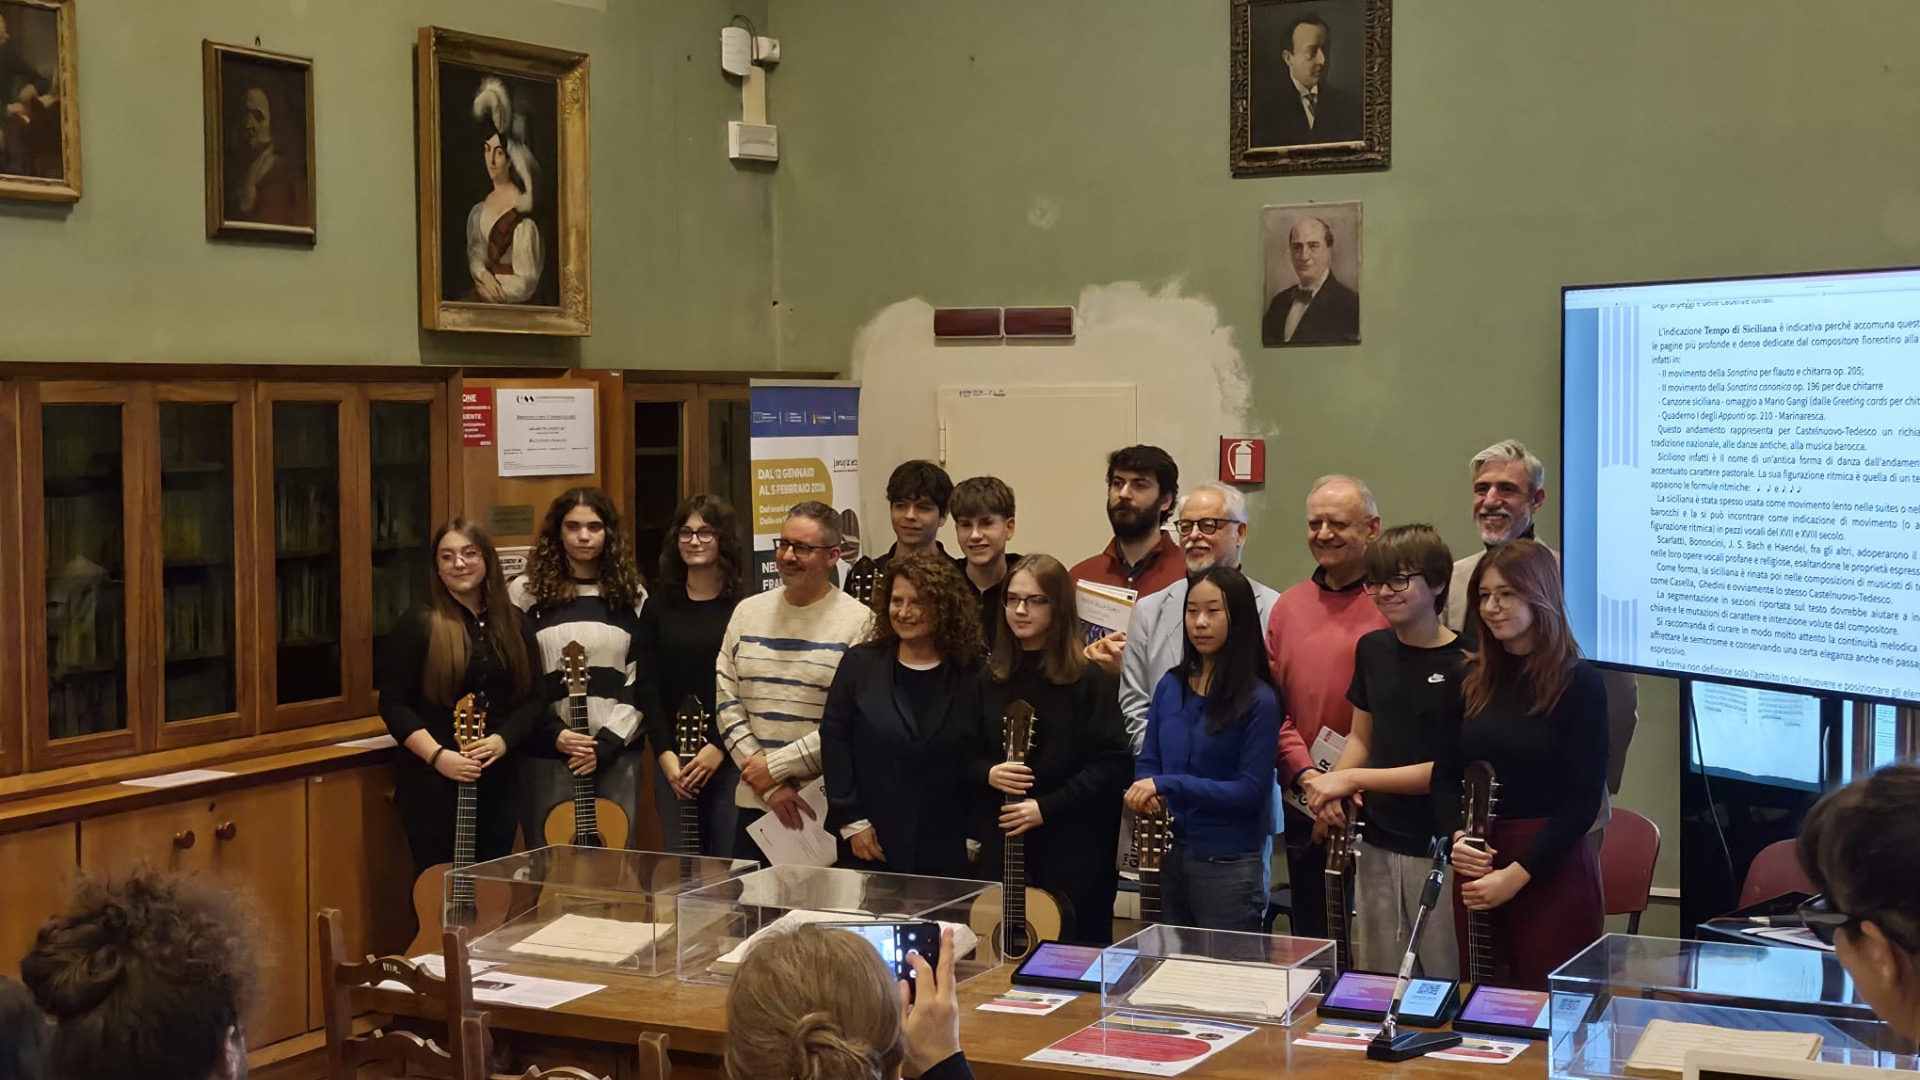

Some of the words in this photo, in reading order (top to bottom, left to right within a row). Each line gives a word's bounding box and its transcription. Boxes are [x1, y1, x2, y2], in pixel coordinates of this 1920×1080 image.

[1704, 325, 1730, 336] Tempo
[1786, 322, 1822, 332] indicativa
[1824, 320, 1851, 332] perché
[1854, 321, 1894, 329] accomuna
[1660, 341, 1682, 352] pagine
[1698, 339, 1730, 351] profonde
[1739, 338, 1760, 347] dense
[1762, 337, 1794, 347] dedicate
[1811, 336, 1859, 347] compositore
[1862, 335, 1901, 344] fiorentino
[1651, 354, 1671, 363] infatti
[1668, 368, 1706, 377] movimento
[1708, 367, 1725, 376] della
[1773, 366, 1794, 376] flauto
[1802, 366, 1832, 375] chitarra
[1668, 383, 1706, 391] movimento
[1708, 382, 1725, 391] della
[1807, 381, 1820, 390] 196
[1853, 381, 1883, 390] chitarre
[1662, 396, 1691, 405] Canzone
[1692, 396, 1720, 405] siciliana
[1726, 396, 1757, 407] omaggio
[1764, 396, 1784, 405] Mario
[1833, 396, 1864, 407] Greeting
[1662, 410, 1695, 421] Quaderno
[1700, 410, 1718, 421] degli
[1760, 410, 1773, 419] 210
[1779, 410, 1825, 420] Marinaresca.
[1658, 424, 1681, 435] Questo
[1685, 424, 1725, 434] andamento
[1796, 425, 1877, 435] Castelnuovo-Tedesco
[1651, 437, 1685, 447] tradizione
[1686, 438, 1721, 450] nazionale,
[1723, 438, 1735, 448] alle
[1736, 439, 1758, 448] danze
[1760, 440, 1788, 451] antiche,
[1790, 440, 1804, 449] alla
[1805, 441, 1832, 450] musica
[1689, 452, 1708, 461] infatti
[1762, 454, 1796, 463] un'antica
[1799, 454, 1822, 464] forma
[1837, 456, 1860, 465] danza
[758, 468, 774, 480] DAL
[782, 468, 814, 479] GENNAIO
[1651, 466, 1688, 475] accentuato
[1689, 467, 1720, 476] carattere
[1721, 468, 1756, 478] pastorale.
[1783, 469, 1824, 480] figurazione
[1826, 471, 1854, 480] ritmica
[1862, 472, 1887, 483] quella
[759, 485, 770, 496] AL
[776, 483, 810, 494] FEBBRAIO
[1651, 480, 1682, 490] appaiono
[1691, 480, 1718, 490] formule
[1666, 494, 1694, 503] siciliana
[1701, 495, 1718, 504] stata
[1719, 498, 1743, 507] spesso
[1745, 498, 1764, 506] usata
[1788, 500, 1830, 509] movimento
[1832, 500, 1852, 510] lento
[1854, 501, 1873, 511] nelle
[1875, 503, 1898, 512] suites
[1651, 506, 1679, 516] barocchi
[1728, 511, 1764, 521] incontrare
[1768, 514, 1788, 522] come
[1793, 514, 1835, 524] indicazione
[1852, 518, 1897, 527] movimento
[1651, 520, 1687, 531] figurazione
[1689, 523, 1715, 534] ritmica)
[1724, 526, 1742, 535] pezzi
[1744, 526, 1765, 535] vocali
[1780, 527, 1793, 537] XVII
[1800, 528, 1817, 538] XVIII
[1819, 530, 1846, 540] secolo.
[1747, 540, 1764, 549] Bach
[1775, 541, 1808, 554] Haendel,
[1857, 547, 1909, 559] adoperarono
[1651, 547, 1666, 557] nelle
[1668, 548, 1681, 558] loro
[1683, 552, 1702, 561] opere
[1704, 552, 1724, 561] vocali
[1725, 553, 1752, 564] profane
[1760, 555, 1793, 568] religiose,
[1795, 558, 1841, 570] esaltandone
[1851, 564, 1888, 574] proprietà
[1657, 561, 1676, 571] Come
[1678, 563, 1700, 575] forma,
[1710, 566, 1738, 576] siciliana
[1747, 569, 1768, 579] rinata
[1784, 572, 1802, 581] nelle
[1804, 575, 1855, 585] composizioni
[1867, 579, 1902, 589] musicisti
[1650, 576, 1668, 584] come
[1698, 578, 1725, 589] Ghedini
[1732, 583, 1774, 594] ovviamente
[1784, 587, 1807, 596] stesso
[1809, 588, 1893, 604] Castelnuovo-Tedesco.
[1668, 592, 1718, 603] segmentazione
[1731, 597, 1756, 606] sezioni
[1759, 599, 1790, 610] riportata
[1808, 603, 1827, 613] testo
[1830, 604, 1868, 616] dovrebbe
[1870, 609, 1899, 619] aiutare
[1650, 602, 1671, 613] chiave
[1686, 607, 1720, 617] mutazioni
[1729, 612, 1760, 621] carattere
[1769, 614, 1807, 626] intenzione
[1809, 618, 1832, 628] volute
[1848, 623, 1899, 635] compositore.
[1665, 619, 1706, 630] raccomanda
[1717, 624, 1740, 633] curare
[1751, 627, 1772, 636] modo
[1774, 629, 1796, 639] molto
[1798, 632, 1826, 642] attento
[1838, 637, 1878, 648] continuità
[1880, 640, 1917, 652] melodica
[1650, 629, 1680, 641] affrettare
[1736, 641, 1781, 652] conservando
[1799, 648, 1818, 656] certa
[1820, 648, 1853, 660] eleganza
[1856, 654, 1879, 663] anche
[1650, 645, 1687, 656] espressivo.
